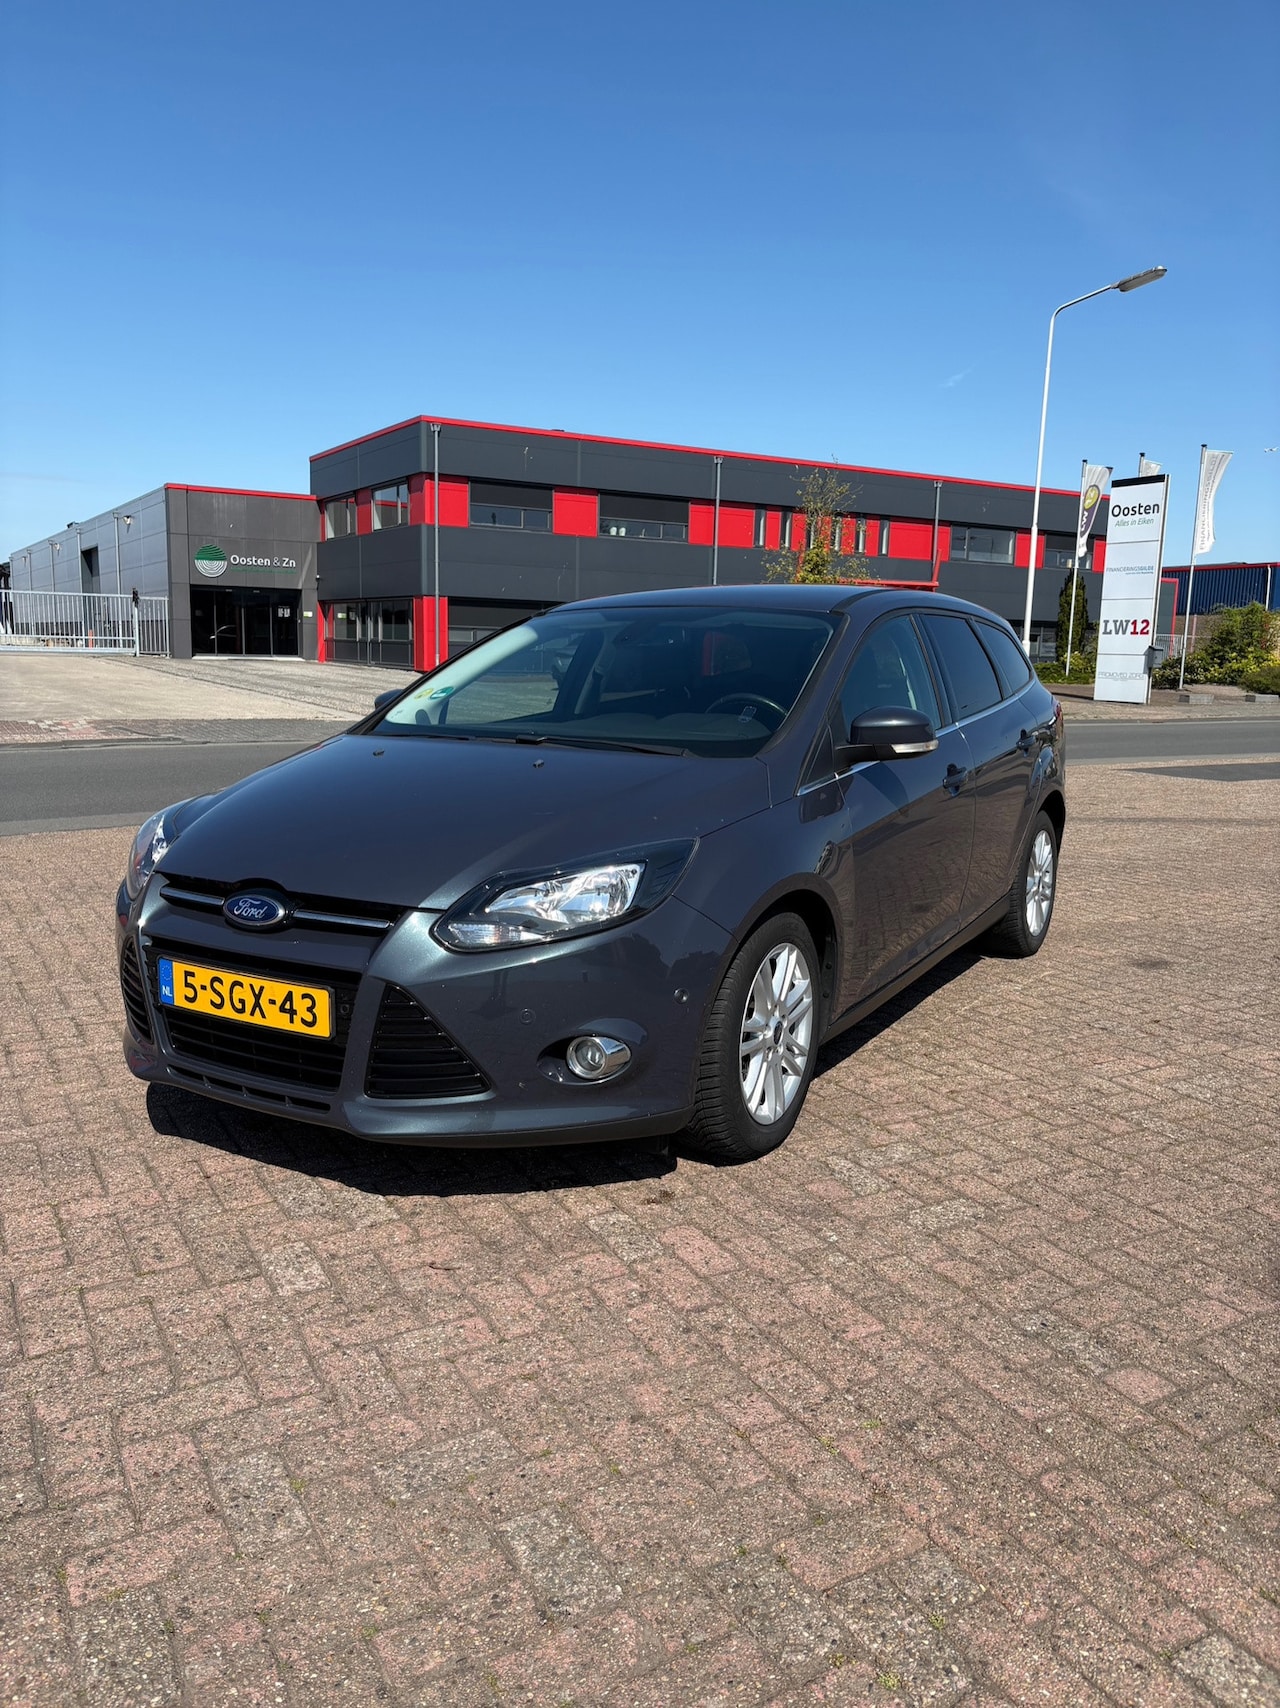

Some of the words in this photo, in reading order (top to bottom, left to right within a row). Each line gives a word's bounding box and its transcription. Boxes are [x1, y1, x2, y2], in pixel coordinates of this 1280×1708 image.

[1111, 502, 1160, 518] Oosten
[1115, 519, 1130, 527] Alles
[1130, 518, 1136, 526] in
[1137, 517, 1154, 526] Eiken
[230, 554, 271, 567] Oosten
[272, 556, 281, 567] &
[282, 557, 296, 568] Zn
[1102, 619, 1150, 635] LW12
[233, 898, 268, 918] Ford
[162, 985, 173, 997] NL
[183, 970, 318, 1028] 5-SGX-43
